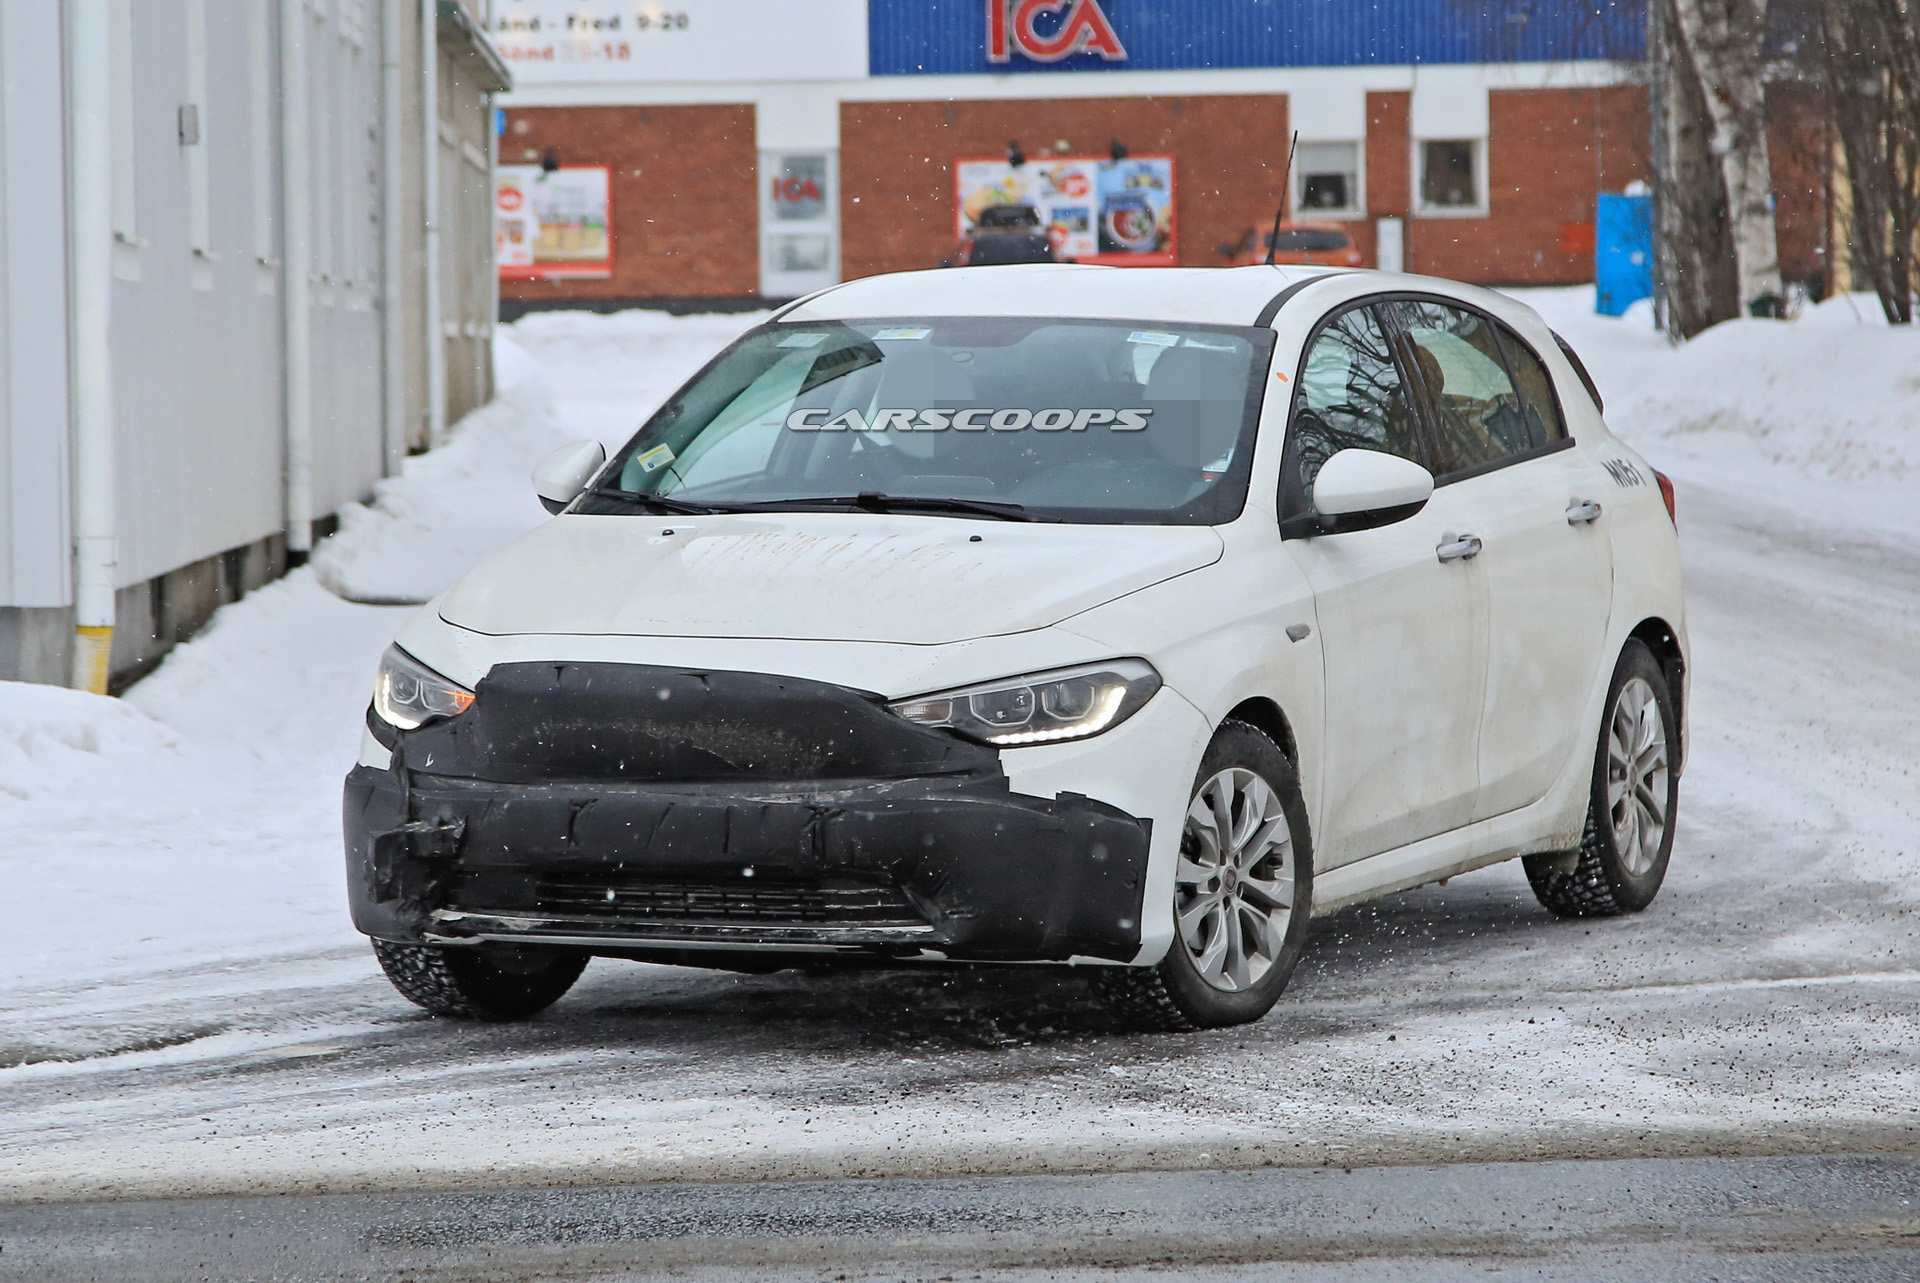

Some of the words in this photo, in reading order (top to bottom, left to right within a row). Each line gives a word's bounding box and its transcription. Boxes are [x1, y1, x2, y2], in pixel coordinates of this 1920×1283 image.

[566, 13, 621, 32] Fred
[636, 11, 688, 32] 9-20
[986, 0, 1129, 63] ICA
[772, 175, 824, 202] ICA
